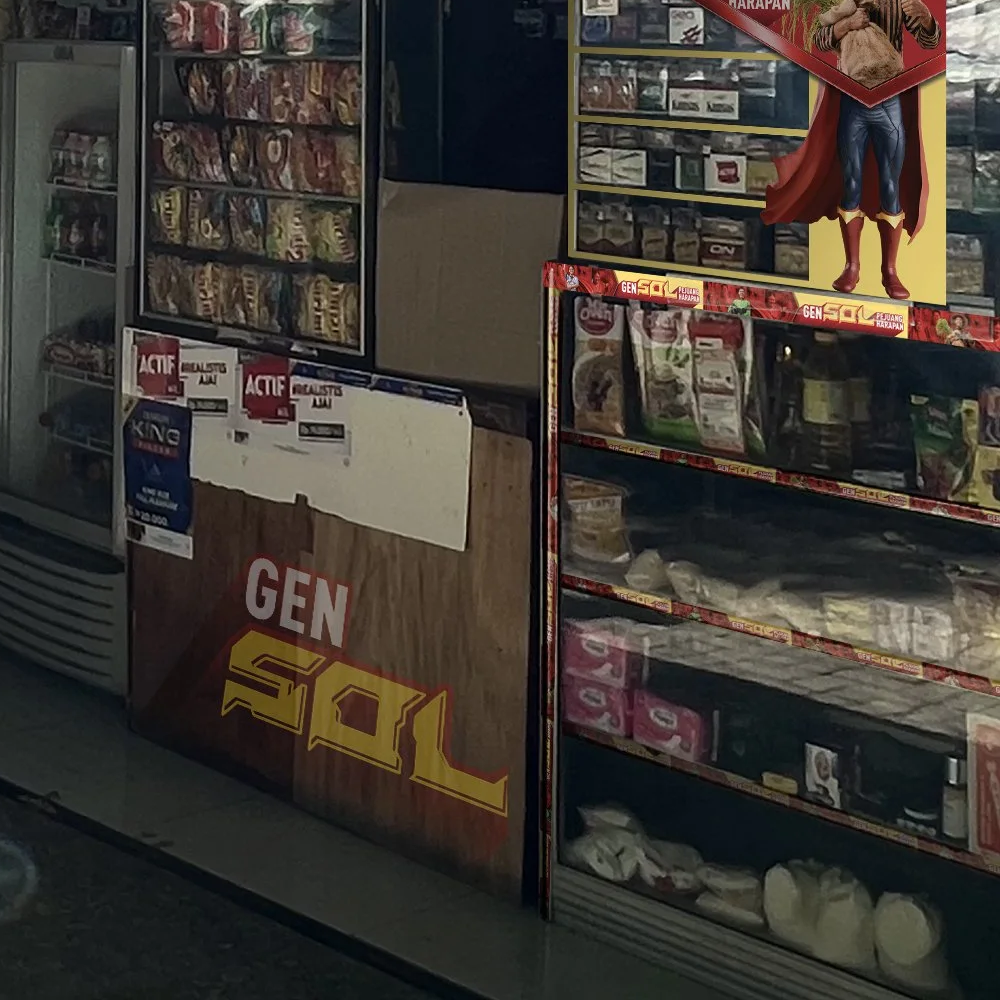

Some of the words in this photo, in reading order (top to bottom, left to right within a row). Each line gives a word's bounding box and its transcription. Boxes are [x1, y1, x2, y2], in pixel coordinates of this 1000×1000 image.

[621, 281, 637, 295] GEN
[637, 279, 679, 299] SOL
[803, 305, 823, 320] GEN
[823, 304, 874, 326] SOL
[876, 312, 904, 322] PEJUANG
[876, 320, 905, 331] HARAPAN
[138, 354, 176, 376] ACTIF
[245, 374, 286, 398] ACTIF
[245, 557, 348, 647] GEN
[221, 629, 508, 817] SOL
